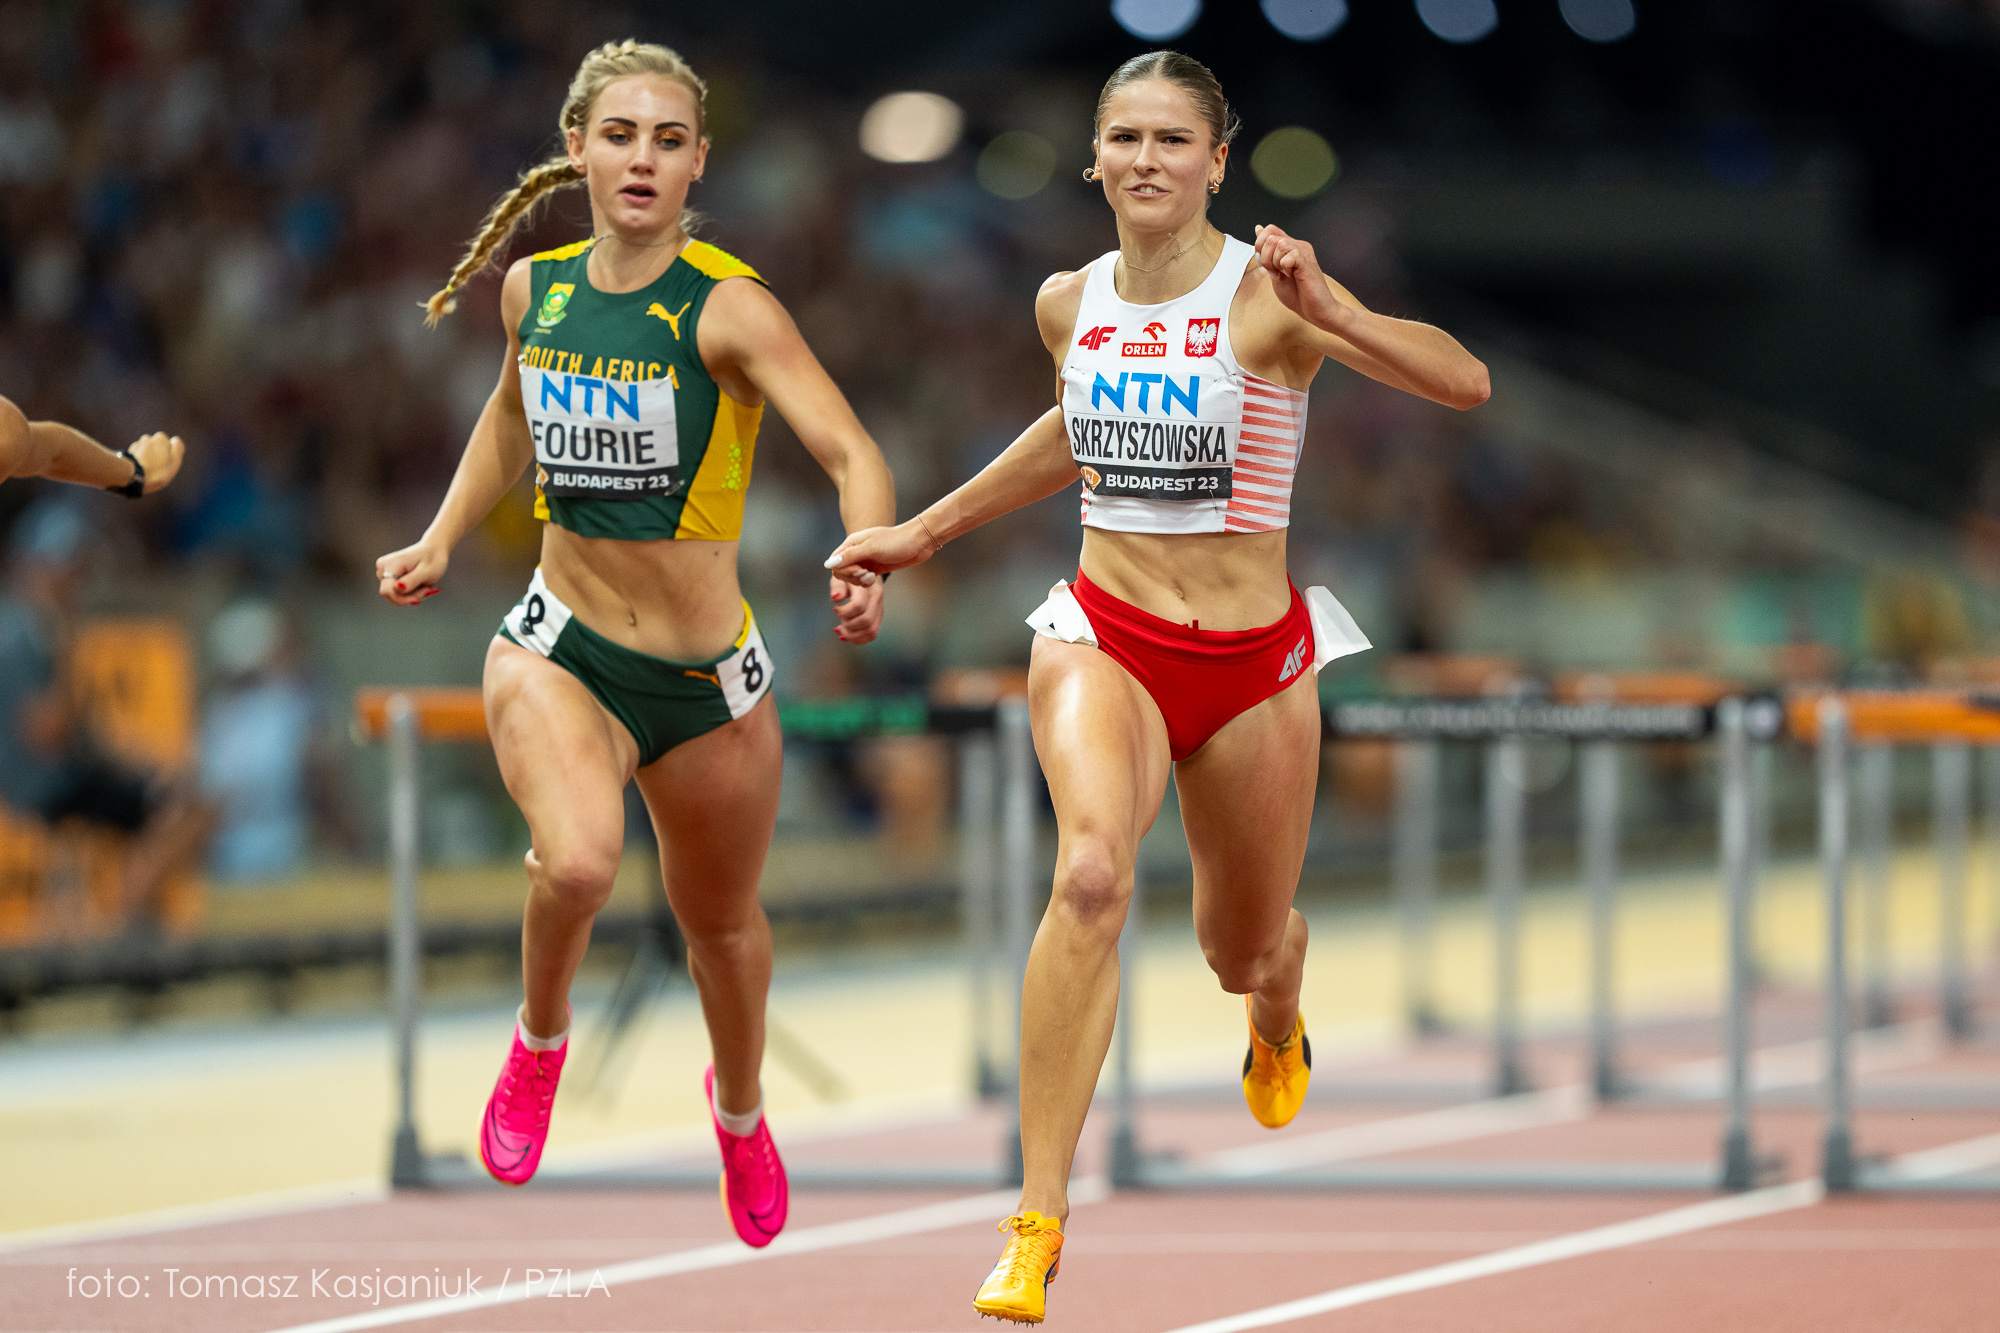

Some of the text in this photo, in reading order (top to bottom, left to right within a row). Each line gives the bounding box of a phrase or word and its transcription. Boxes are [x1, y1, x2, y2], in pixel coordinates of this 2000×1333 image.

[1078, 326, 1117, 350] 4F
[1123, 344, 1164, 356] ORLEN
[523, 344, 583, 375] SOUTH
[540, 372, 640, 423] NTN
[1091, 371, 1200, 418] NTN
[532, 420, 656, 465] FOURIE
[1071, 416, 1227, 463] SKRZYSZOWSKA
[553, 472, 670, 490] BUDAPEST 23
[1106, 473, 1219, 491] BUDAPEST 23
[742, 647, 763, 693] 8
